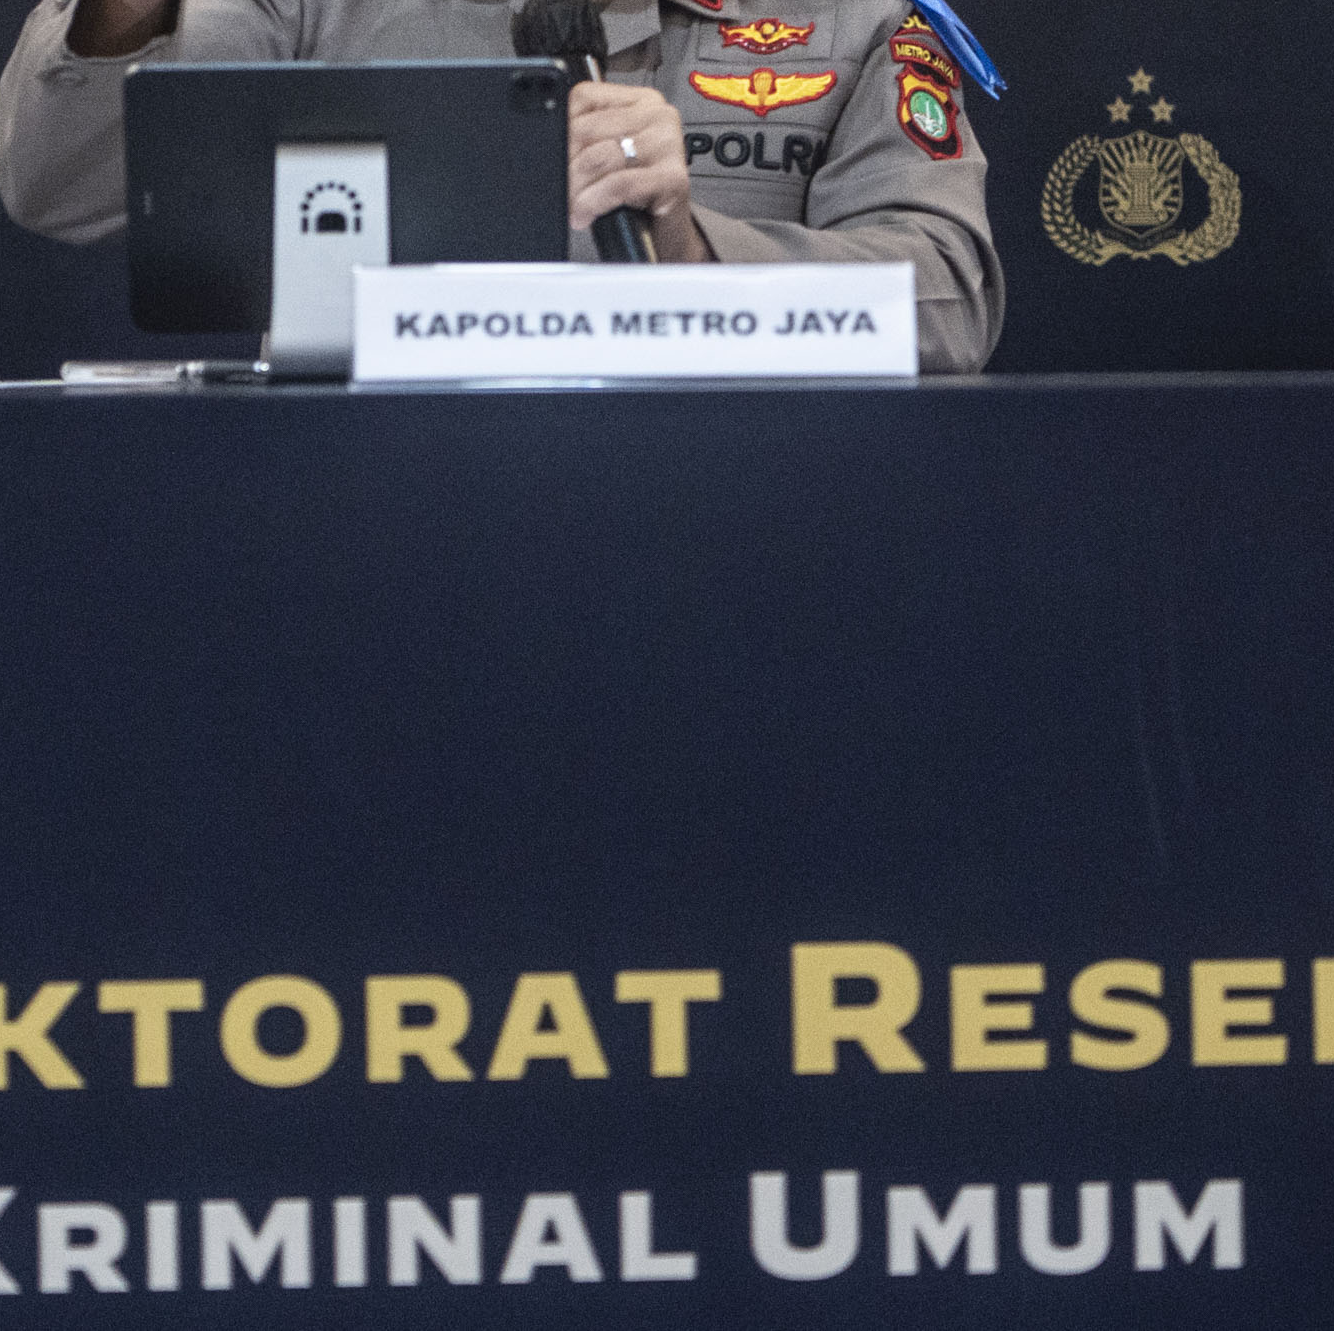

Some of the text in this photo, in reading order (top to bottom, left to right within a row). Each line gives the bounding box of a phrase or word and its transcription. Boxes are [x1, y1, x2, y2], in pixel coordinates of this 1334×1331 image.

[895, 44, 931, 62] METRO
[394, 309, 877, 339] KAPOLDA METRO JAYA
[750, 1170, 1243, 1281] UMUM
